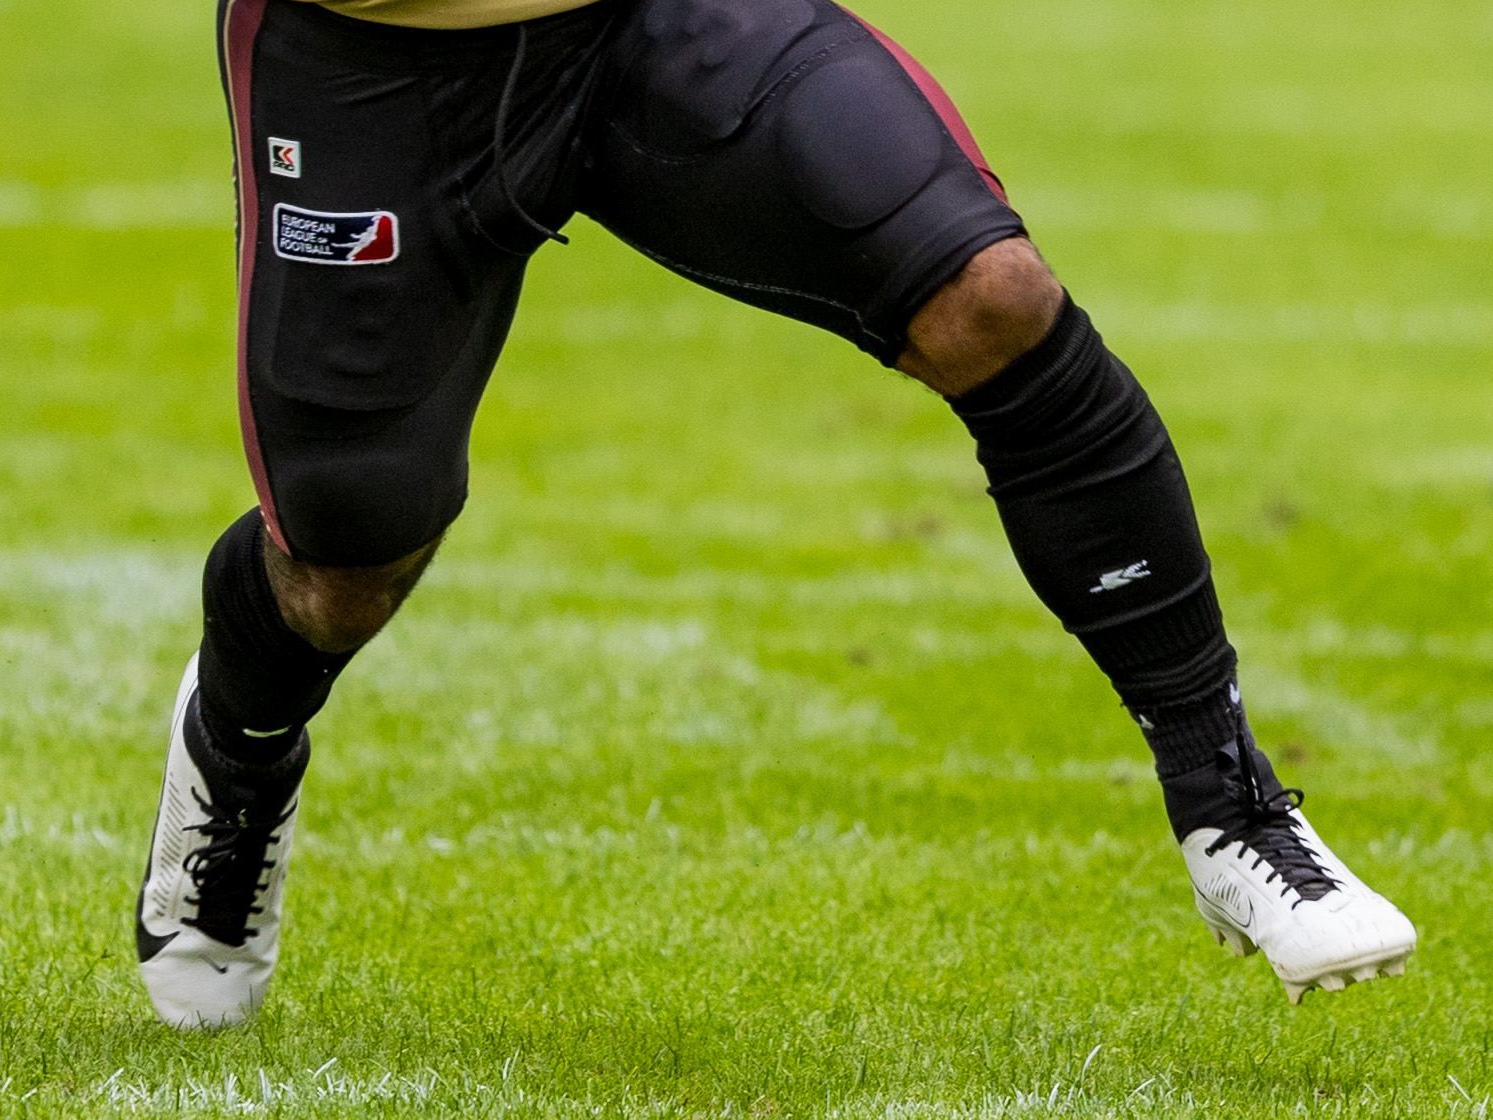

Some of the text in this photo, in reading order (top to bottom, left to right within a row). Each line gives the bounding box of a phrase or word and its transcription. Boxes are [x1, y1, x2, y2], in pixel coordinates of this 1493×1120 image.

[281, 214, 336, 234] EUROPEAN
[280, 226, 317, 244] LEAGUE
[280, 237, 334, 256] FOOTBALL
